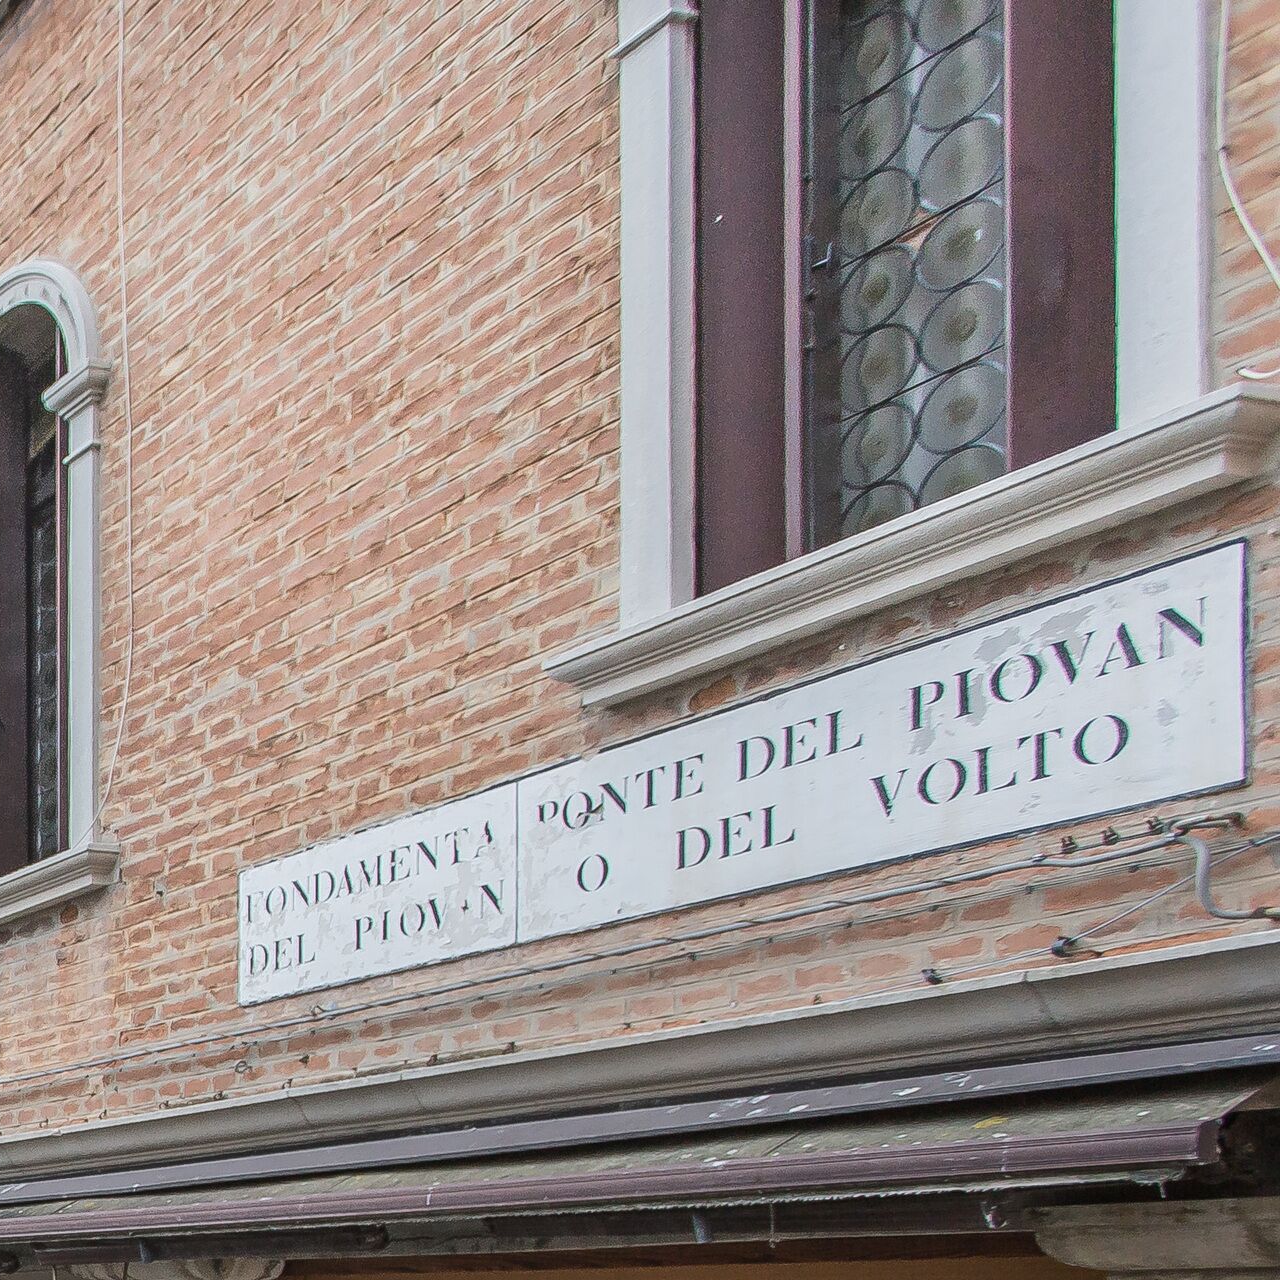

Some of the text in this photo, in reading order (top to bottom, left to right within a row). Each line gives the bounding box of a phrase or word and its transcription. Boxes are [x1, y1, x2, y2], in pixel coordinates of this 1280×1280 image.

[736, 709, 864, 783] DEL
[907, 595, 1208, 733] PIOVAN
[246, 819, 496, 924] FONDAMENTA
[576, 713, 1131, 893] O DEL VOLTO
[247, 878, 505, 976] DEL PIOVN
